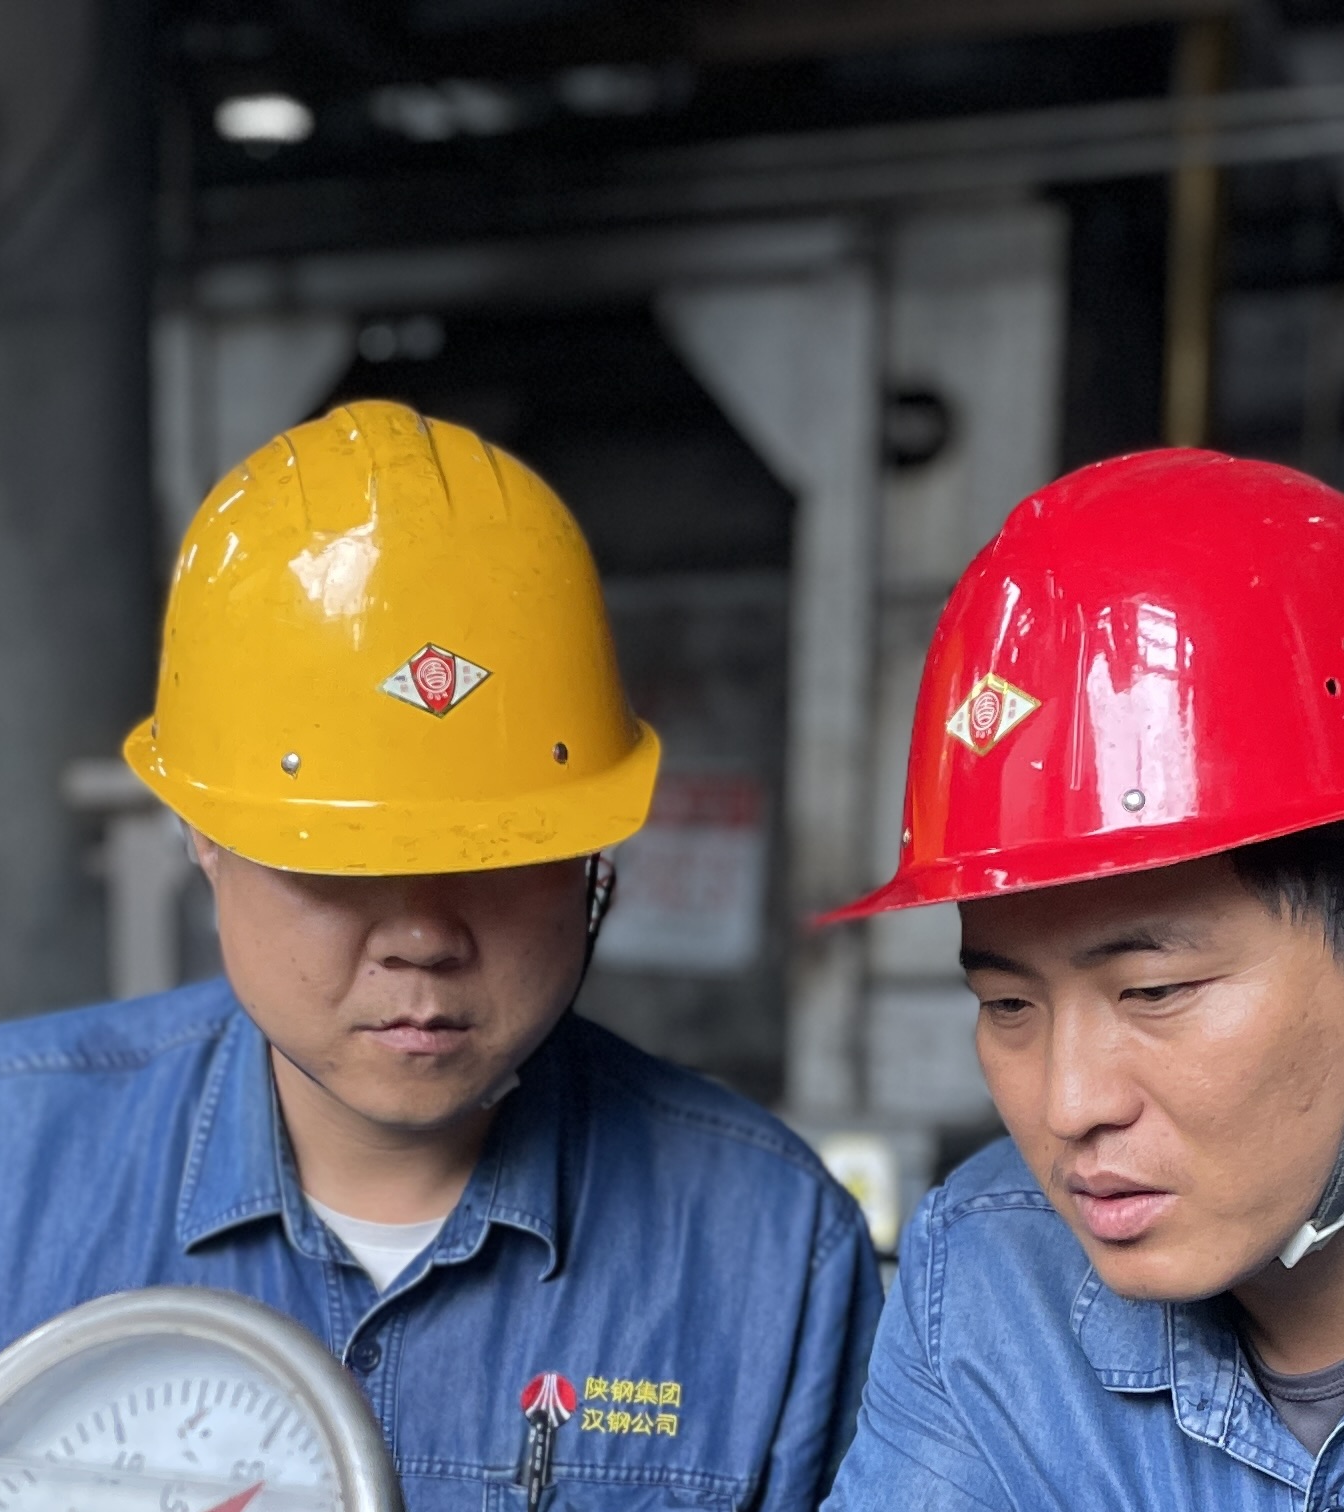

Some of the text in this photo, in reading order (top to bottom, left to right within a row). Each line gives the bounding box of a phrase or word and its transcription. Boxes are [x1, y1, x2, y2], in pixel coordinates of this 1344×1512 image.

[584, 1375, 682, 1407] 陕钢集团
[582, 1407, 678, 1436] 汉钢公司
